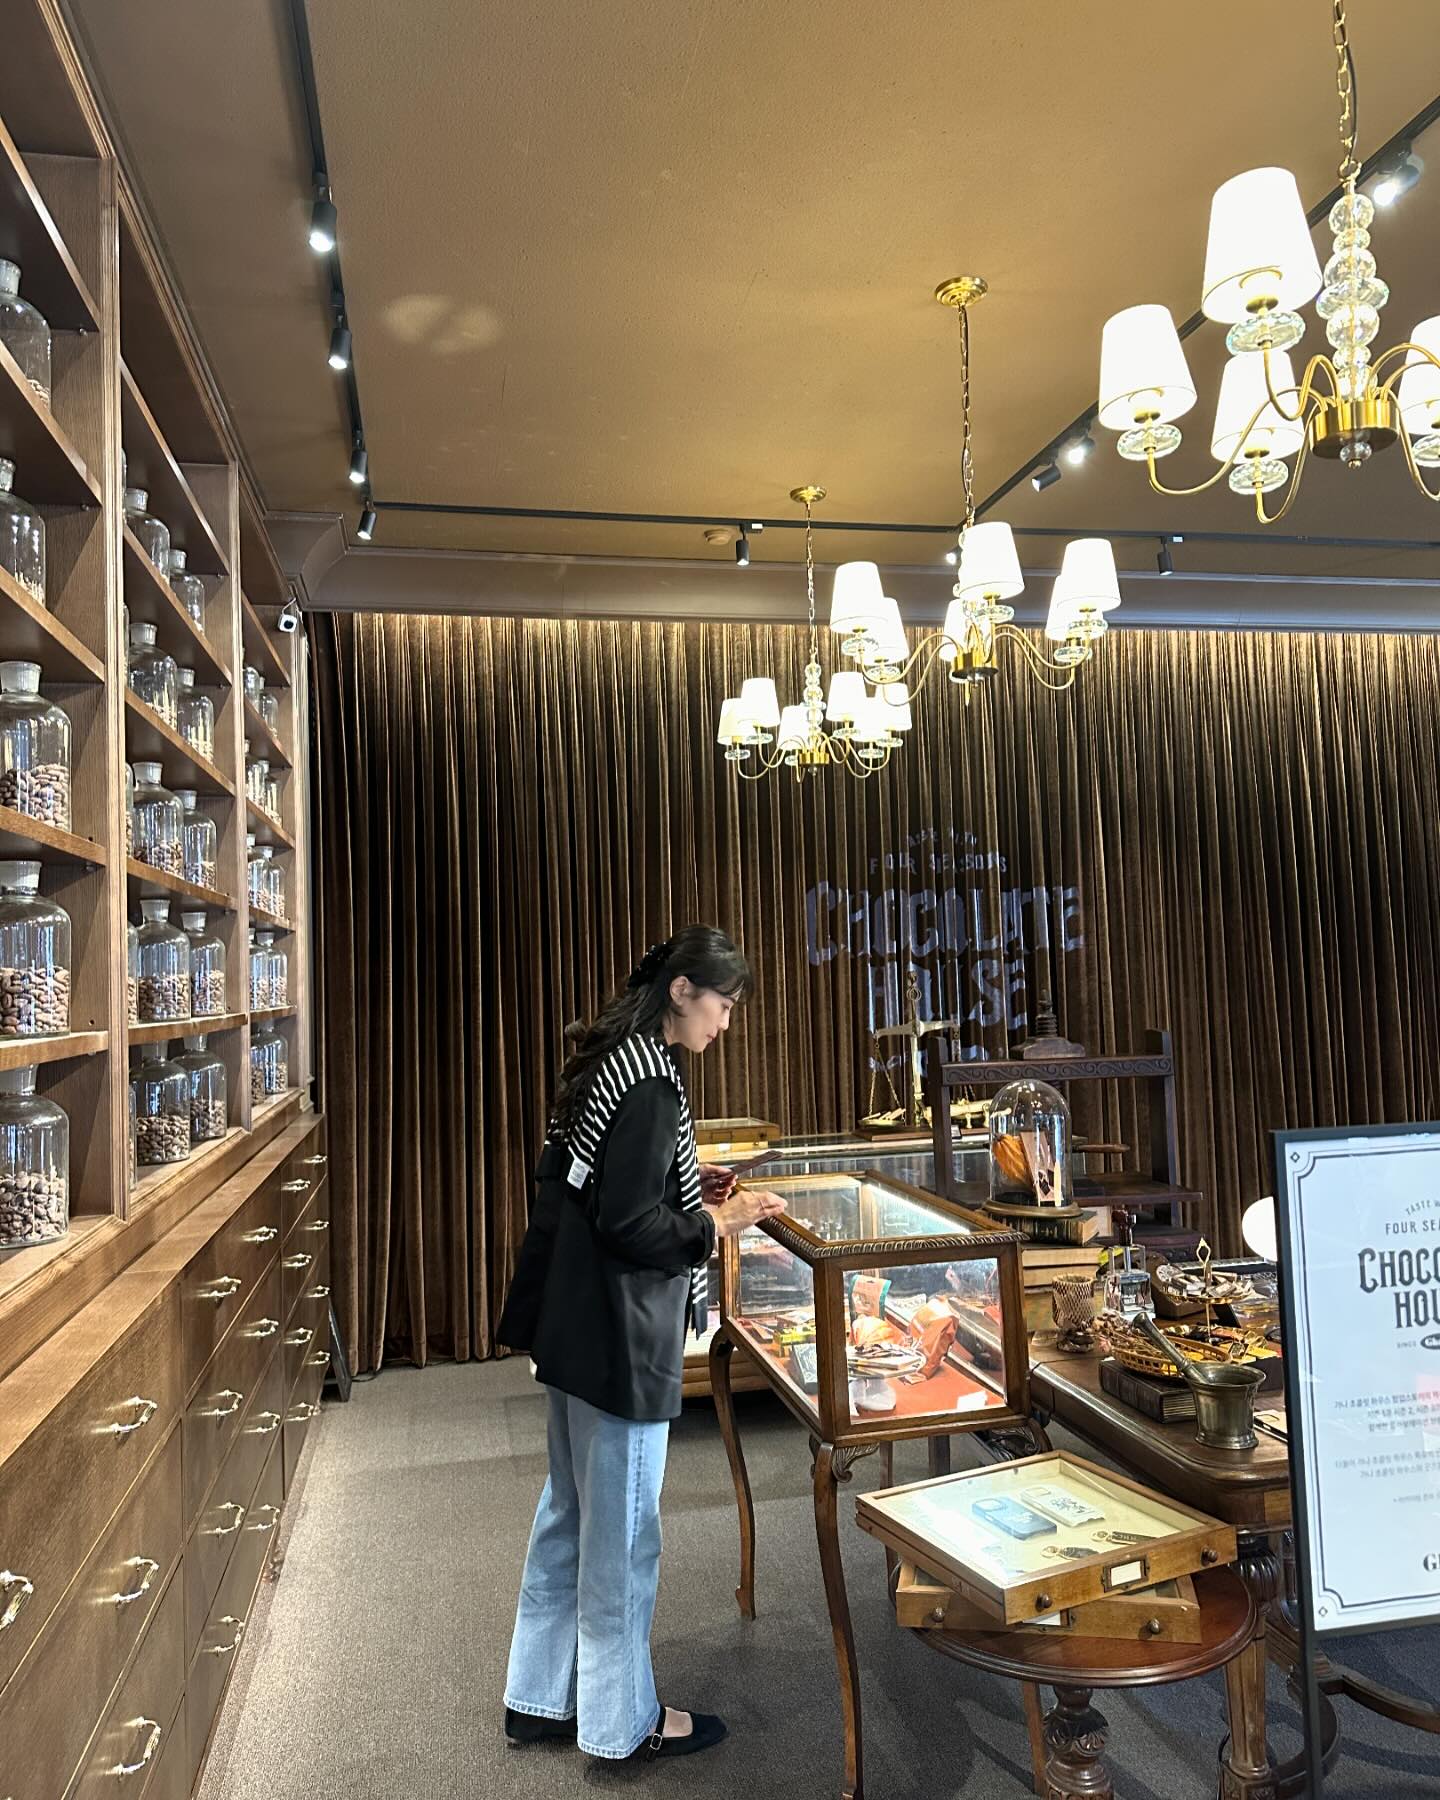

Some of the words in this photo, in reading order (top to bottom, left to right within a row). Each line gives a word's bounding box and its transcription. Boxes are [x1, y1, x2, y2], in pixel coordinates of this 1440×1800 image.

[1405, 1199, 1430, 1216] TASTE
[1385, 1221, 1417, 1235] FOUR
[1422, 1218, 1440, 1232] SE
[1423, 1553, 1440, 1572] G
